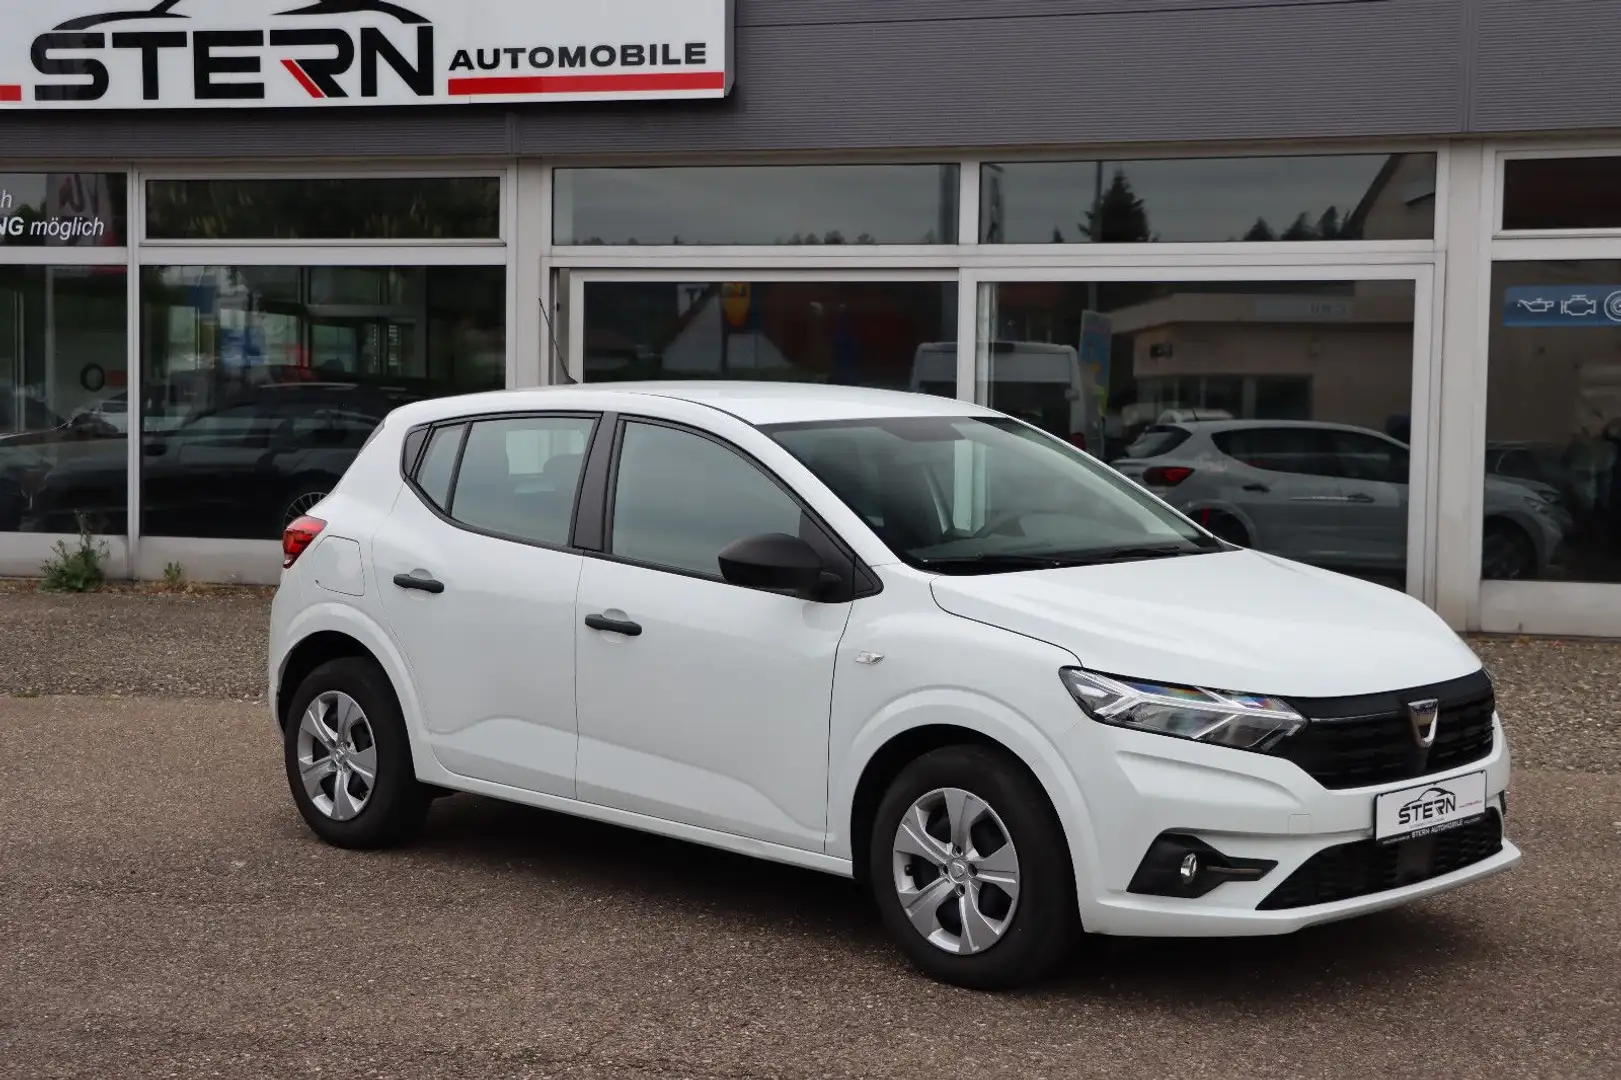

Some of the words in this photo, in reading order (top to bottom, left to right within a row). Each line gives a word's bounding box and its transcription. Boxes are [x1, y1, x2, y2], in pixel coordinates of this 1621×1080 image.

[30, 25, 434, 101] STERN
[449, 42, 707, 72] AUTOMOBILE
[30, 216, 104, 240] möglich
[1398, 795, 1456, 825] STERN
[1411, 828, 1430, 839] STERN
